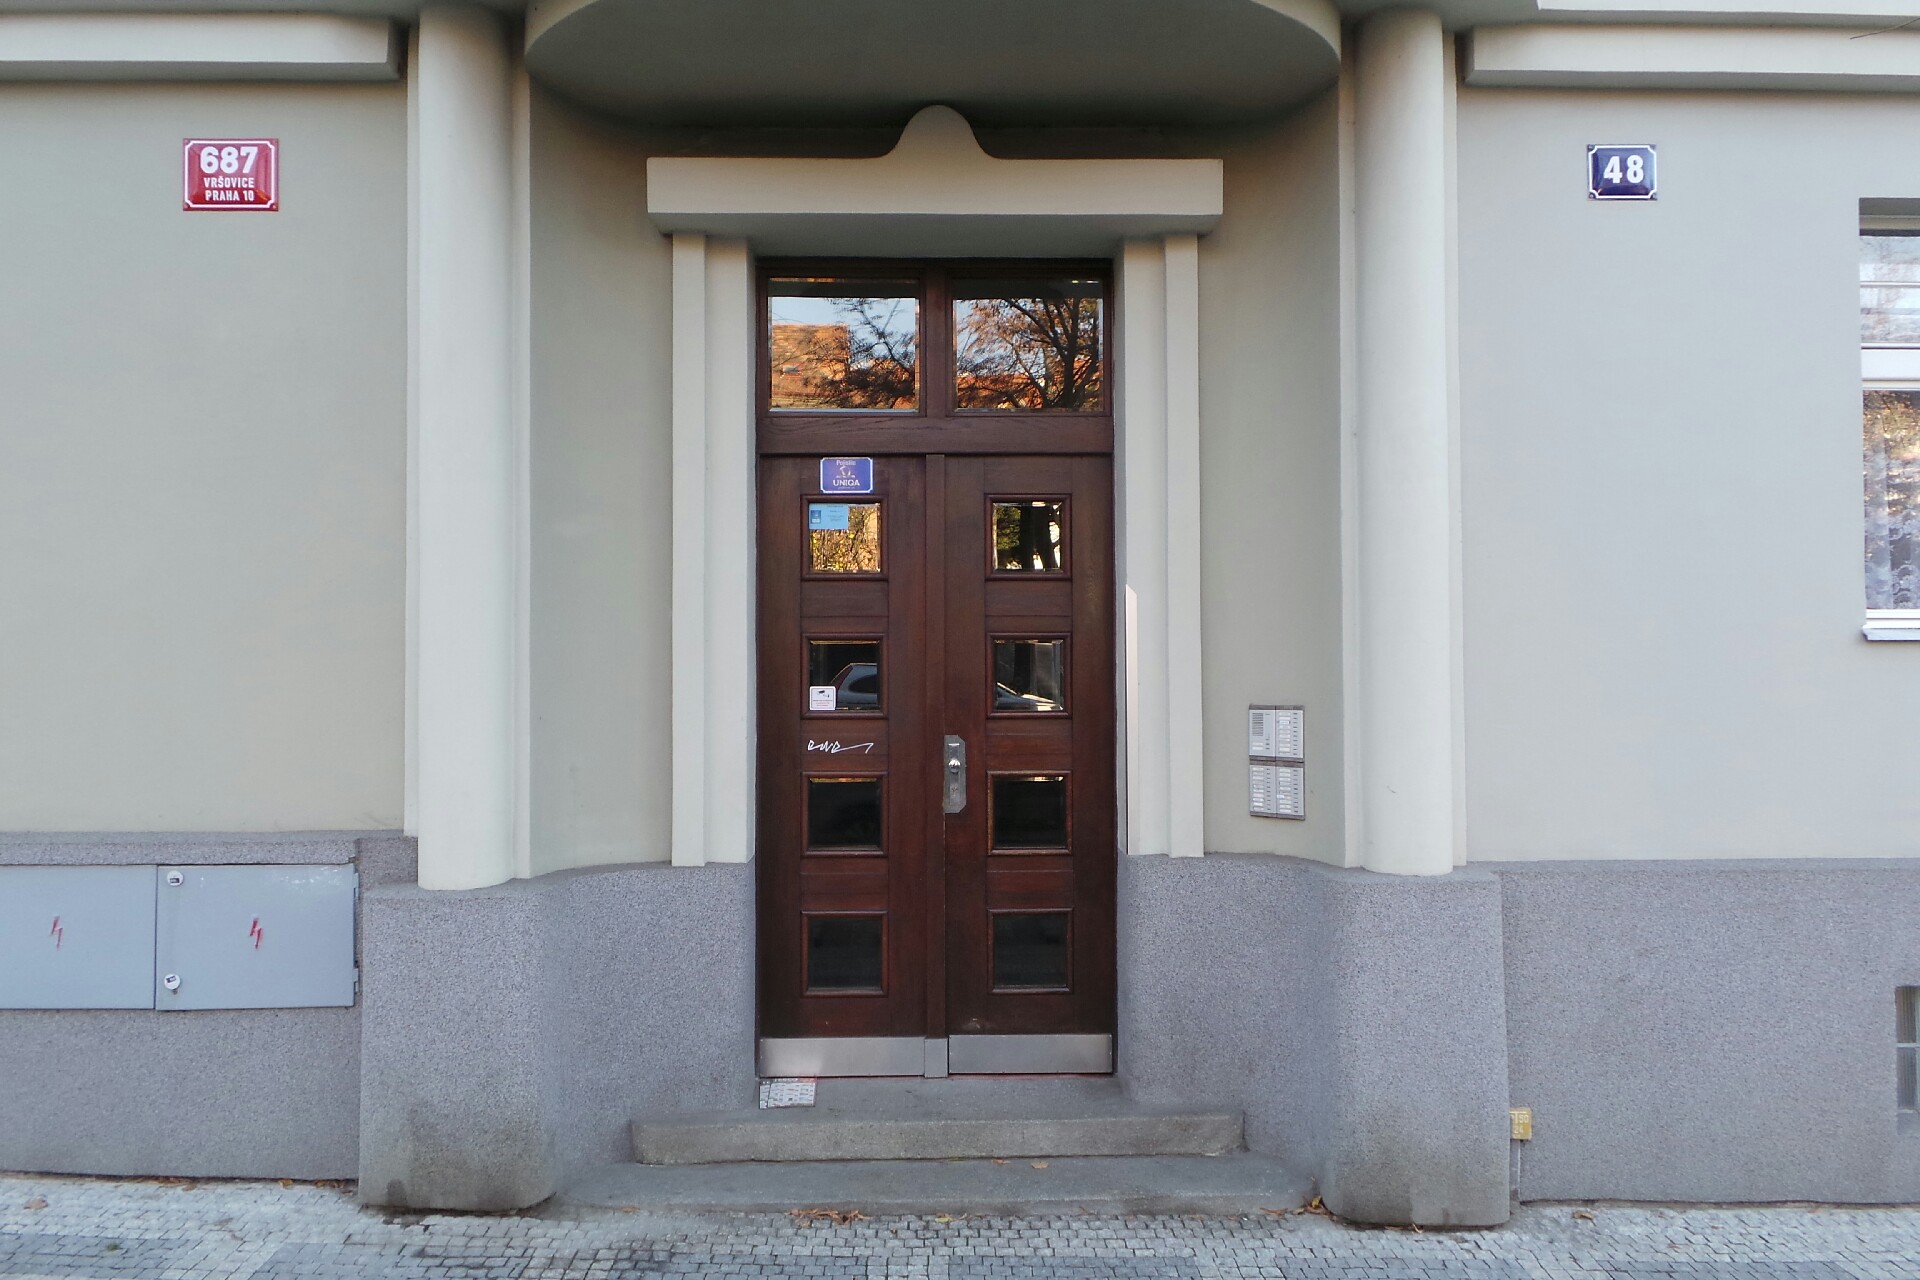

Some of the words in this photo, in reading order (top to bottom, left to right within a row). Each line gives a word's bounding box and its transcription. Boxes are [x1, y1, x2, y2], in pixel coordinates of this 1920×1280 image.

[200, 146, 258, 174] 687
[1603, 154, 1644, 184] 48
[203, 175, 255, 188] VRŠOVICE
[205, 190, 240, 201] PRAHA
[242, 190, 254, 201] 10
[832, 479, 860, 487] UNIQA
